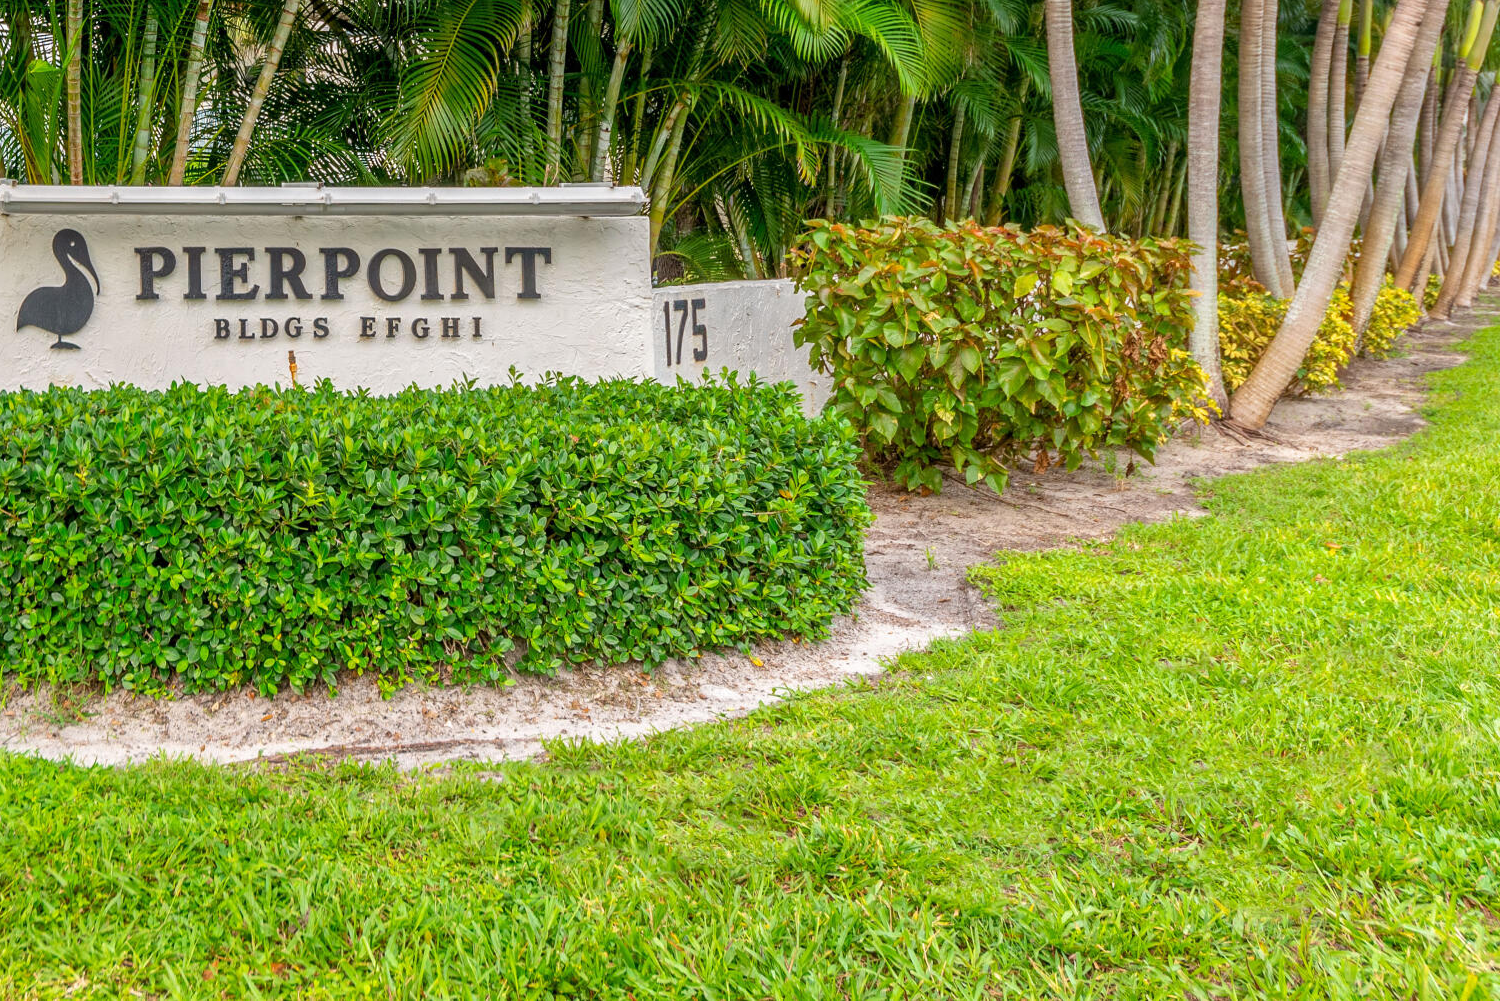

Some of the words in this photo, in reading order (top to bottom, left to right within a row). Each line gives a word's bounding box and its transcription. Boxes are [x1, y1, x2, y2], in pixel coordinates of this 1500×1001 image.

[134, 245, 552, 302] PIERPOINT
[214, 316, 330, 340] BLDGS
[359, 316, 483, 340] EFGHI
[663, 298, 708, 367] 175
